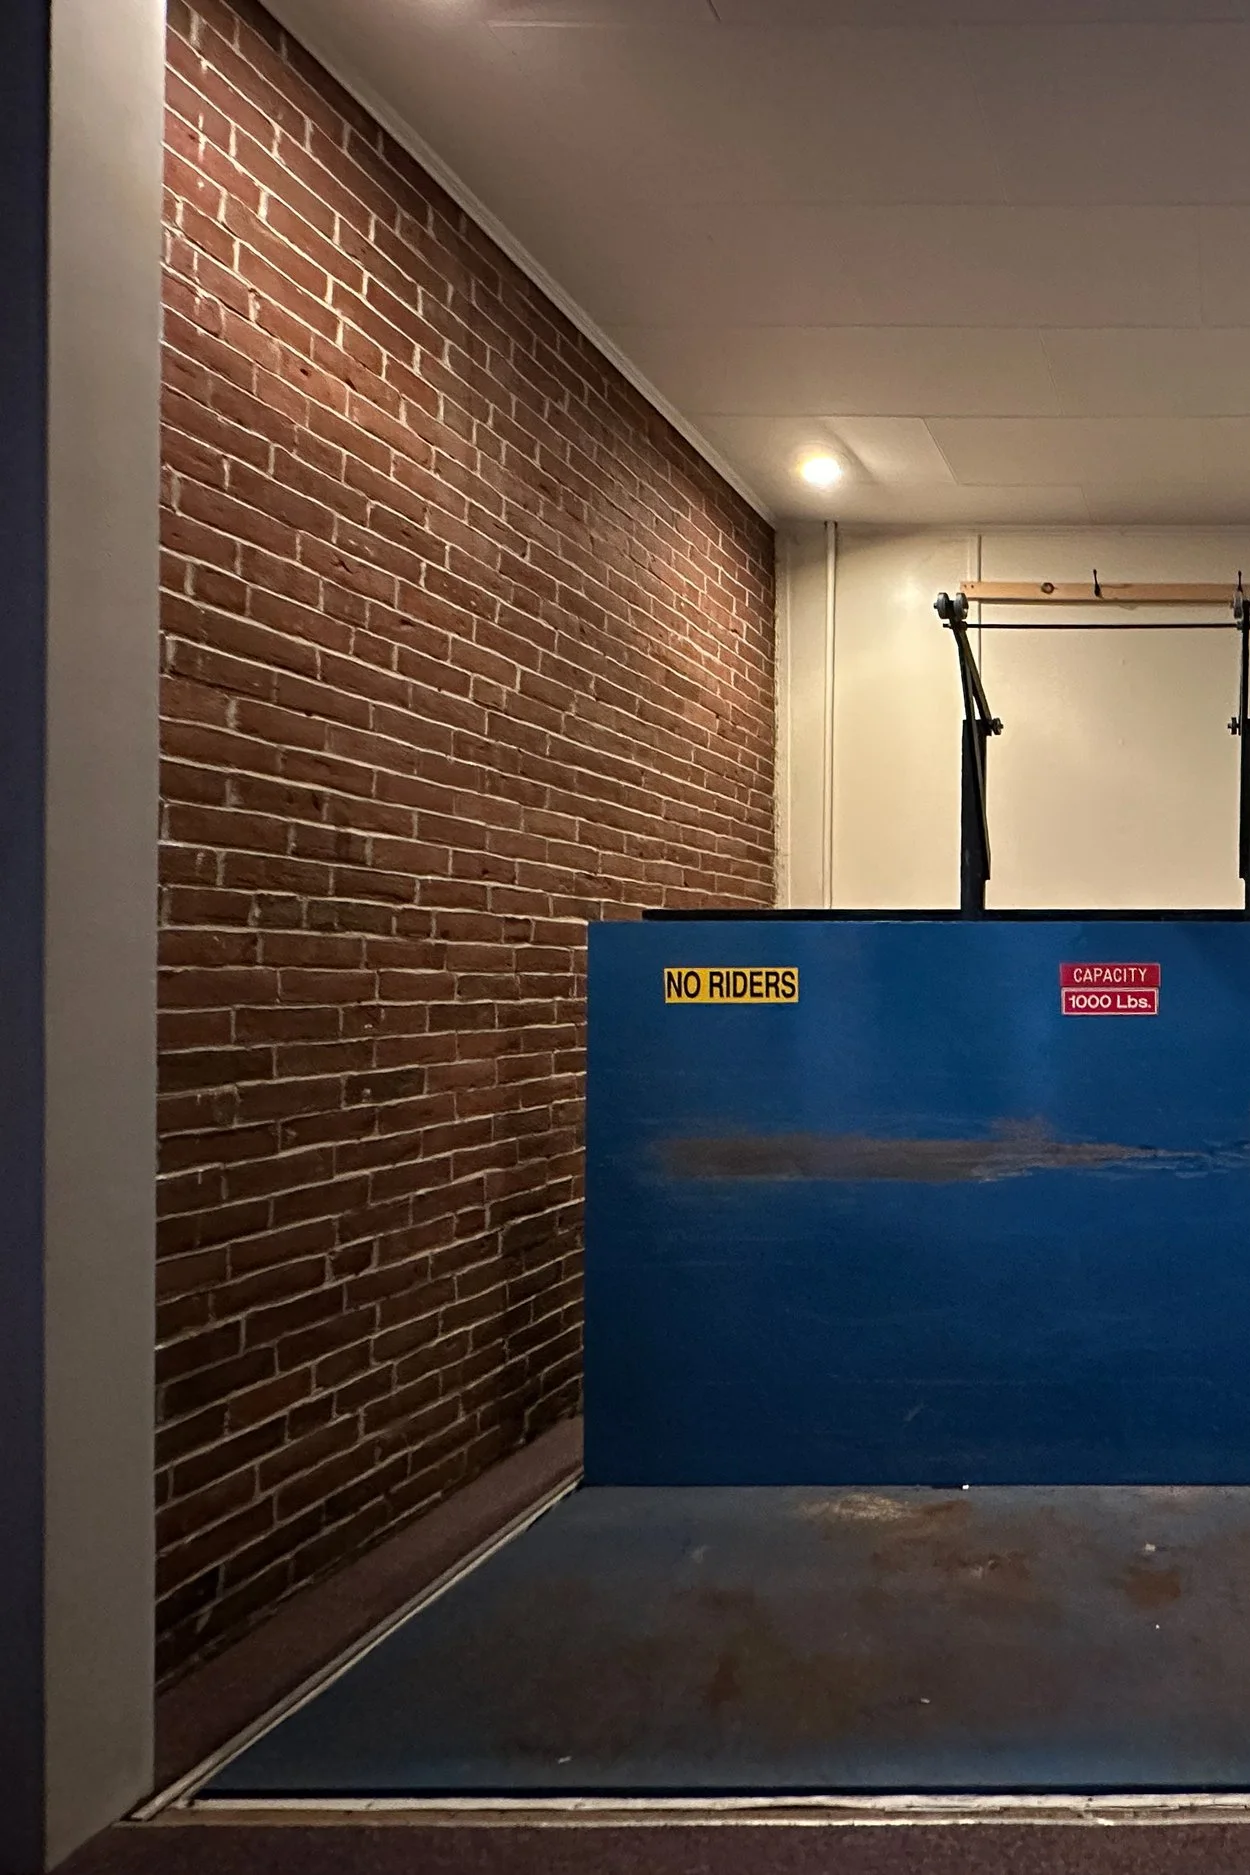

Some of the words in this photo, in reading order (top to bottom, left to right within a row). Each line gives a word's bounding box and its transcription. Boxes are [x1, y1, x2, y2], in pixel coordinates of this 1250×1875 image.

[1073, 967, 1147, 983] CAPACITY
[667, 971, 701, 998] NO
[709, 971, 796, 998] RIDERS
[1069, 995, 1112, 1009] 1000
[1116, 995, 1152, 1009] Lbs.
